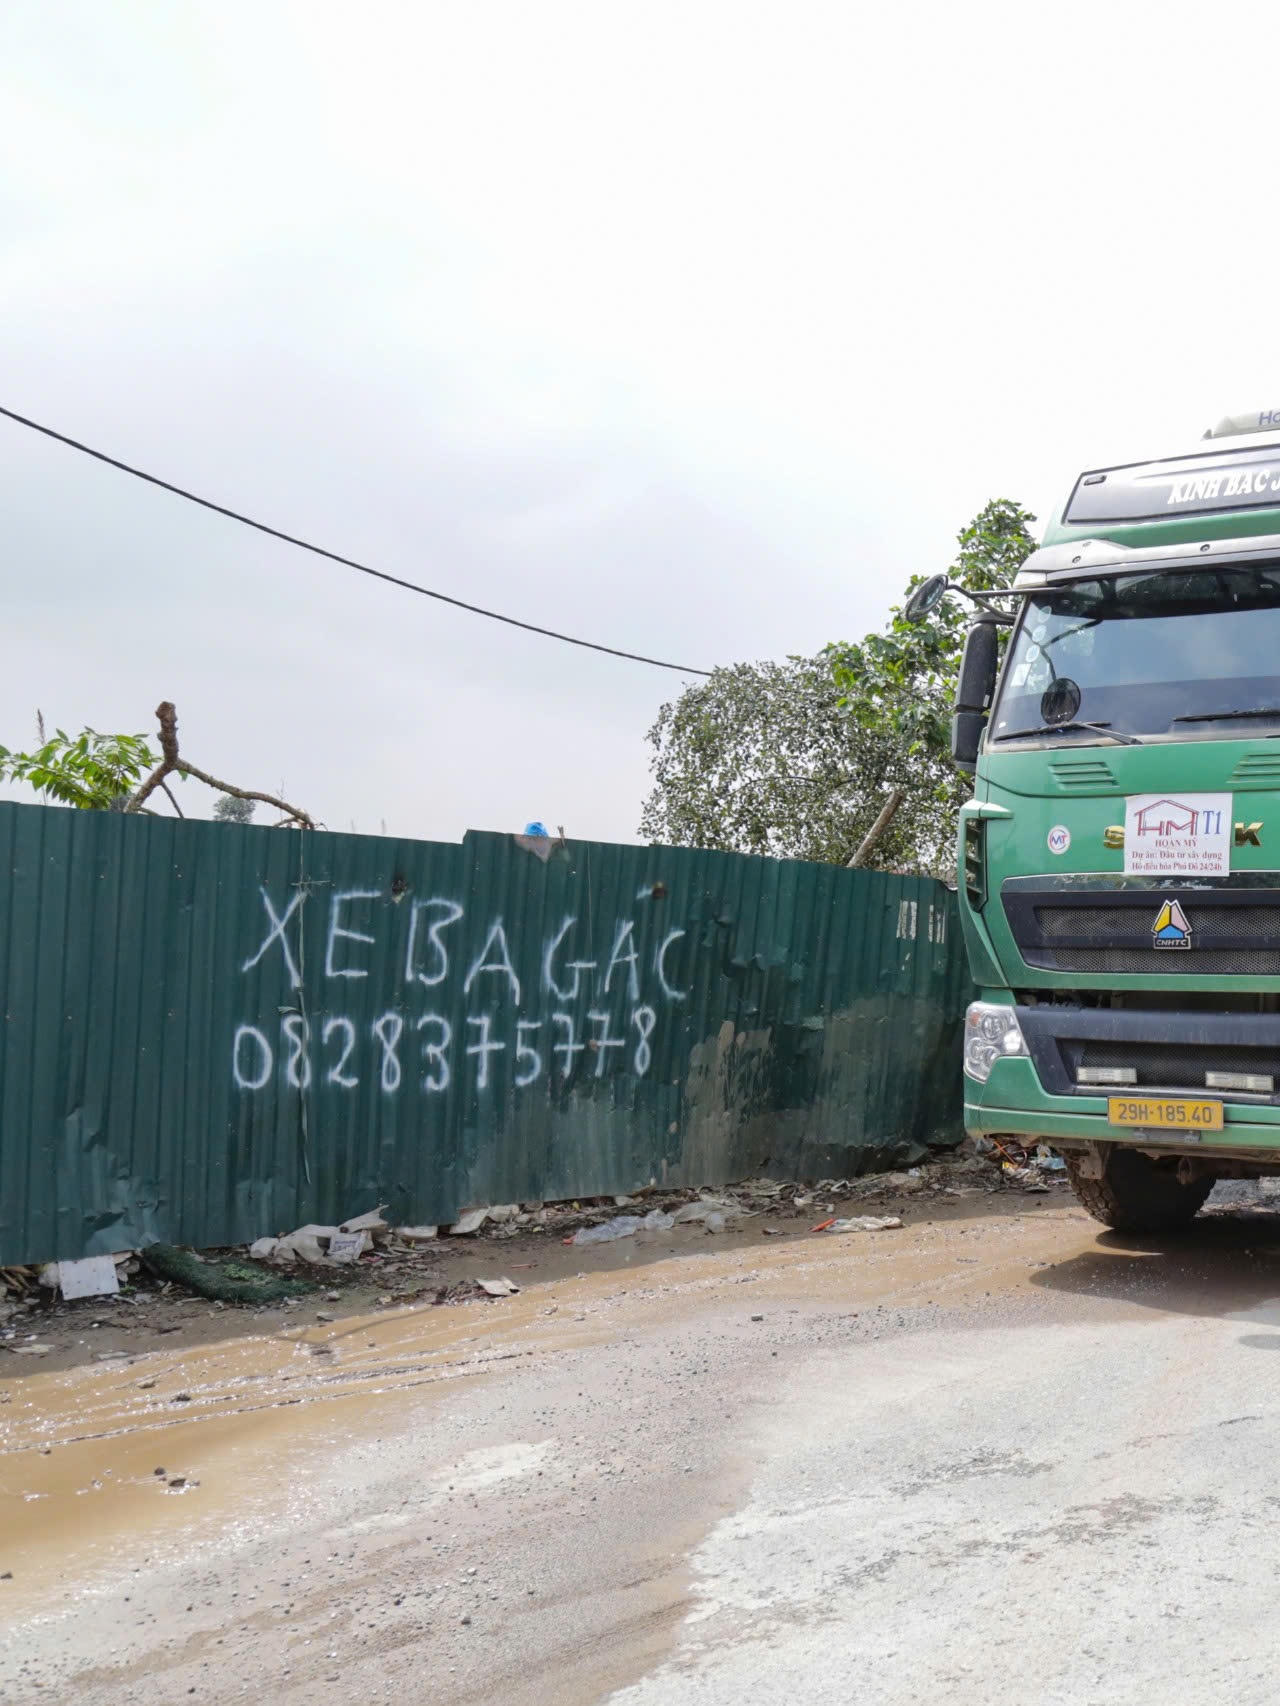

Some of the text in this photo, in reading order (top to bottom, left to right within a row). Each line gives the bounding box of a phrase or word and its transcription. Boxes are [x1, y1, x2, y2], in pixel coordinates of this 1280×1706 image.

[1167, 479, 1221, 505] KINH
[1202, 810, 1222, 835] T1
[243, 885, 382, 989] XE
[405, 895, 520, 1006] BA
[1155, 938, 1187, 946] CNHTC
[233, 1005, 657, 1092] 0828375778
[1117, 1102, 1213, 1123] 29H-185.40
